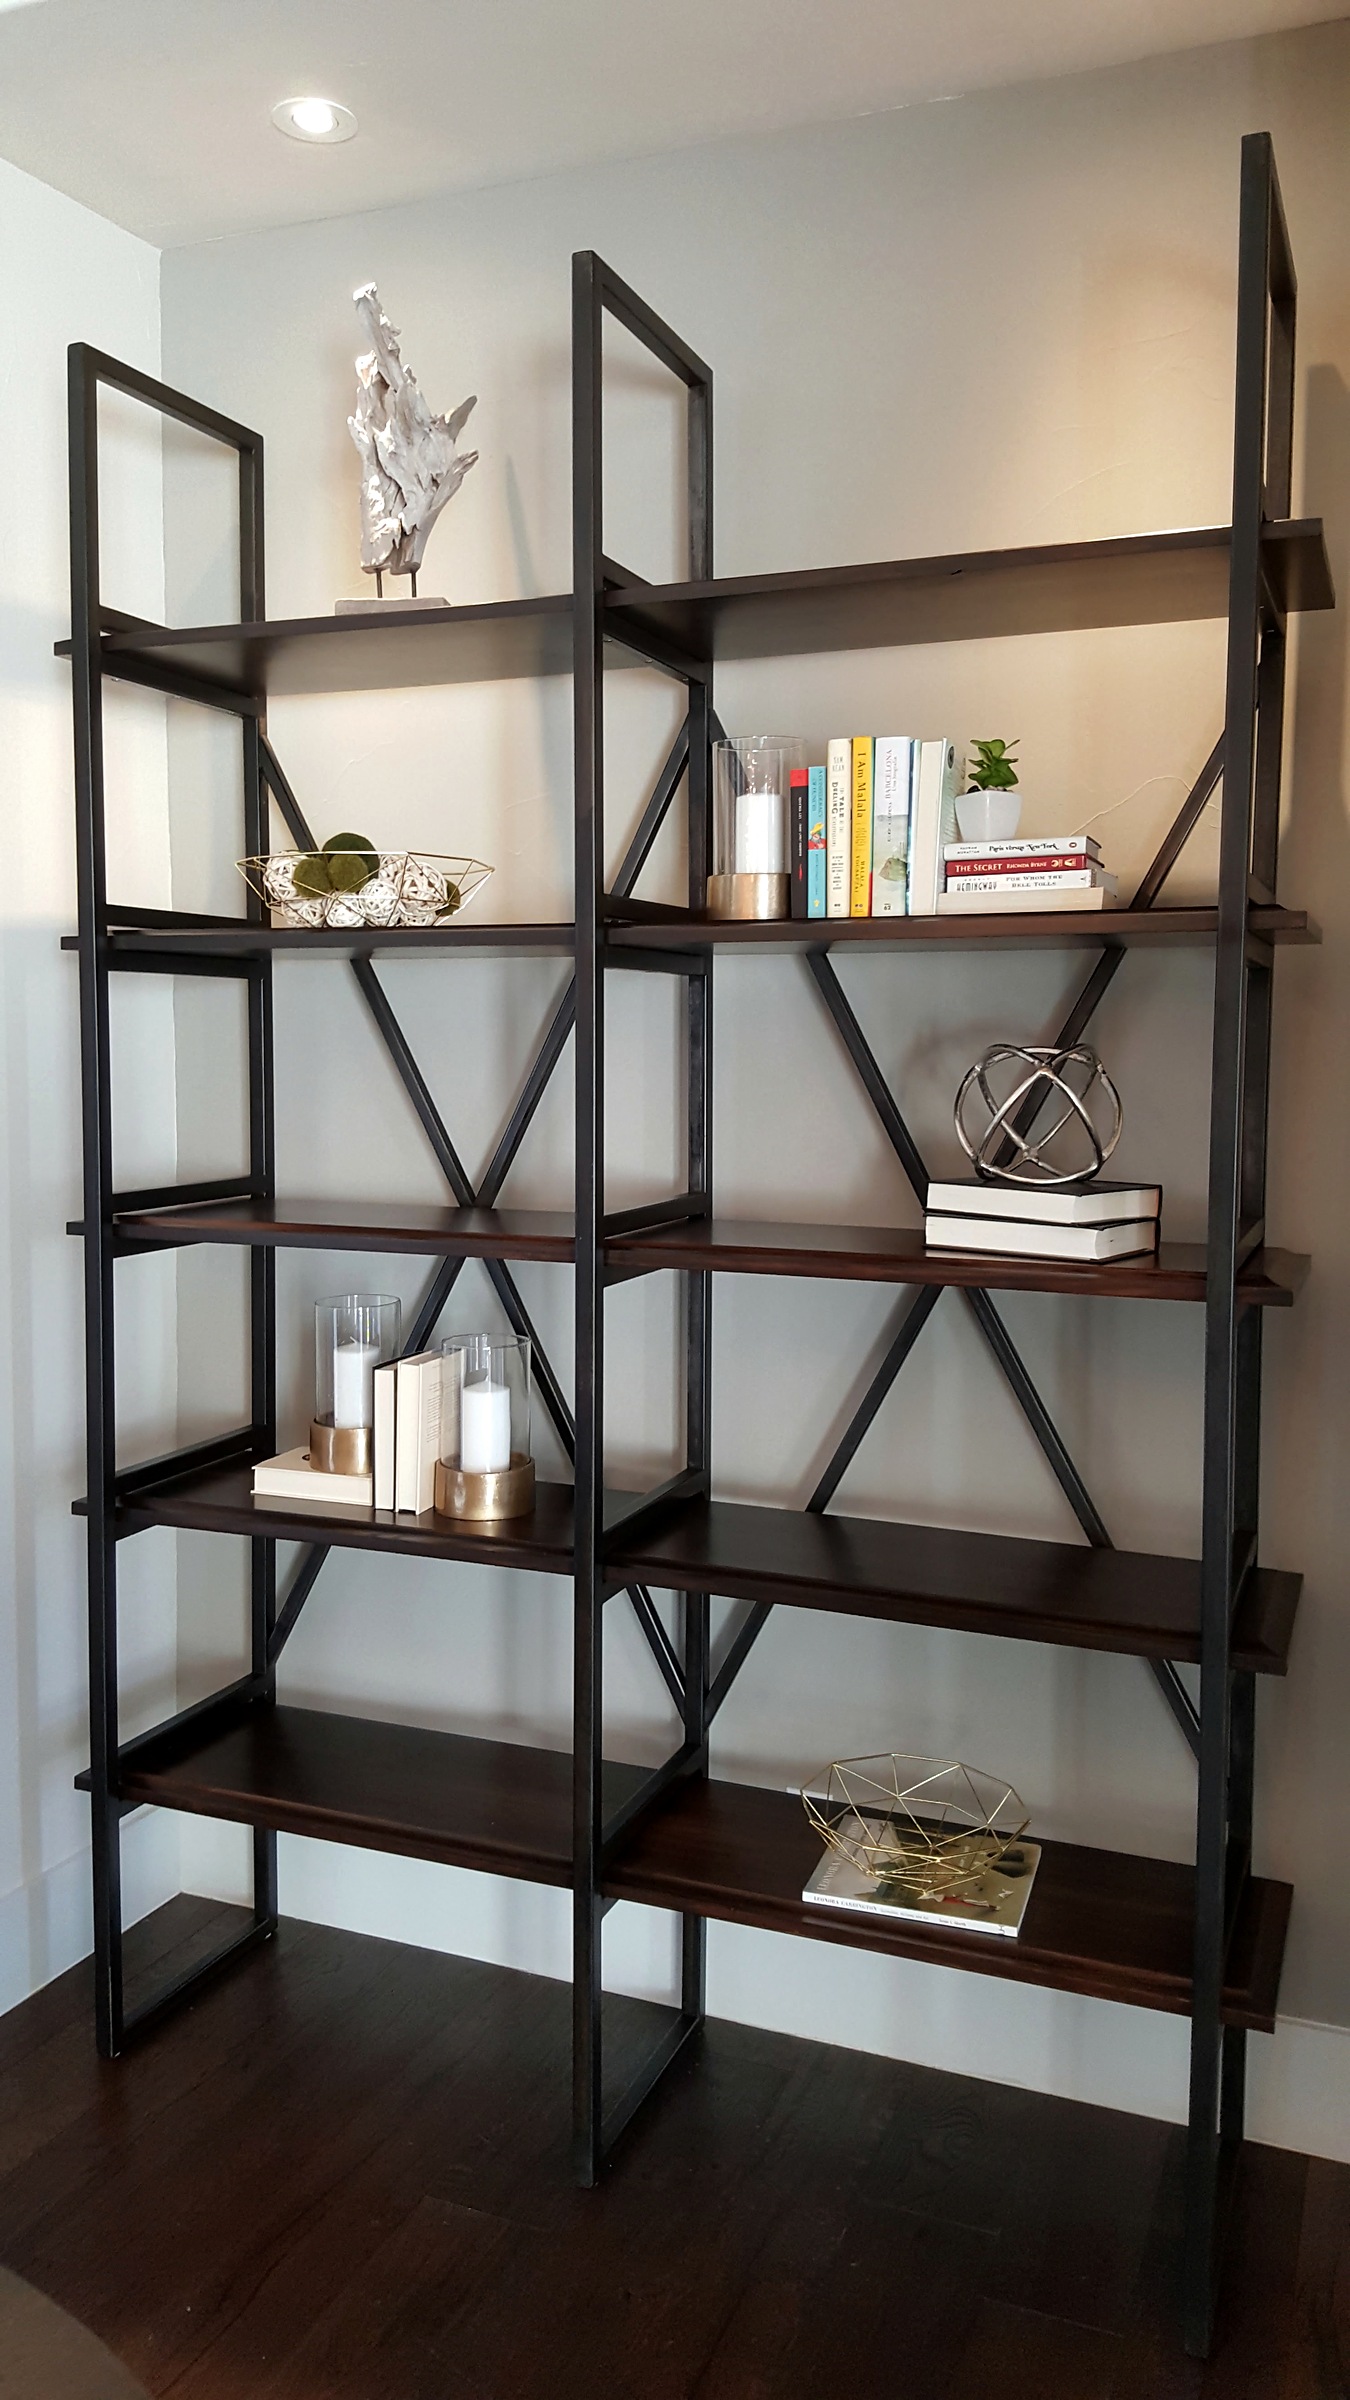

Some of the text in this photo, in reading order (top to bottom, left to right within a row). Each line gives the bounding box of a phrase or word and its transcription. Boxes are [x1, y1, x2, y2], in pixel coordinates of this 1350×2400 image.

[857, 761, 867, 778] Am
[885, 749, 893, 799] BARCELONA
[857, 782, 867, 818] Malala
[989, 845, 1004, 853] Paris
[1026, 843, 1041, 852] New
[955, 864, 971, 873] THE
[973, 863, 1003, 872] SECRET
[956, 881, 998, 892] HEMINGWAY
[813, 1895, 878, 1911] LEONORA CARRINGTON
